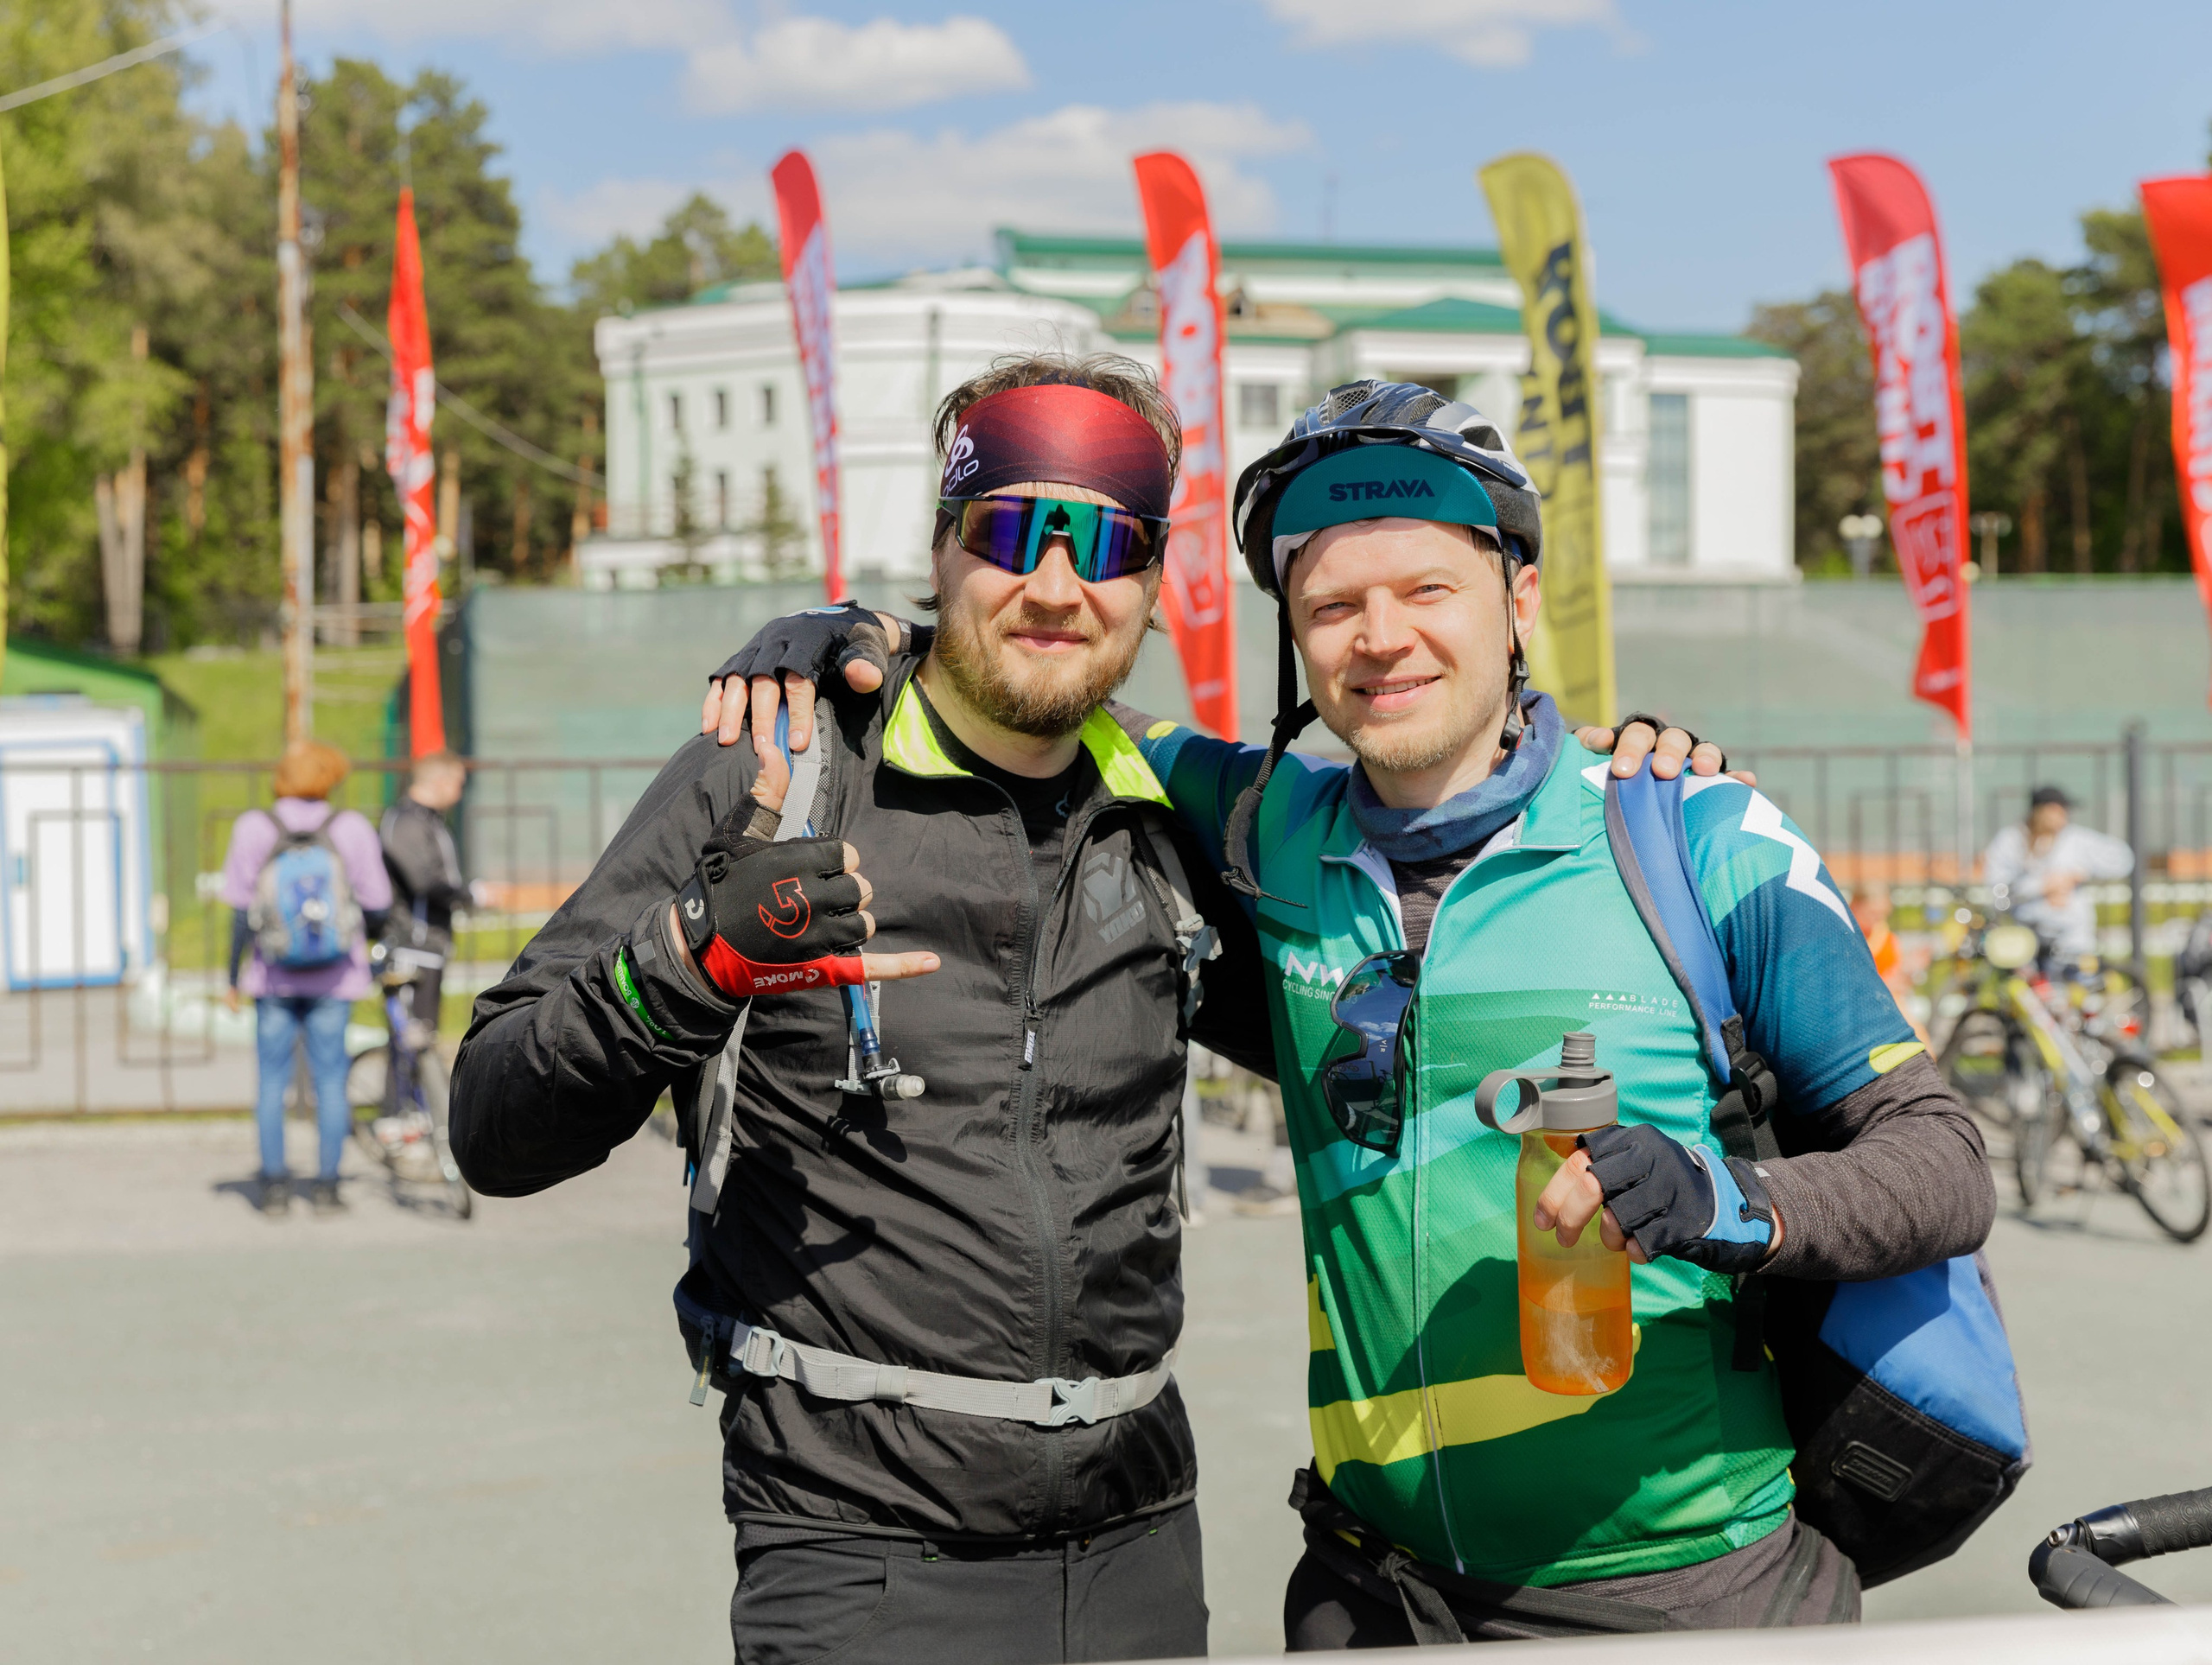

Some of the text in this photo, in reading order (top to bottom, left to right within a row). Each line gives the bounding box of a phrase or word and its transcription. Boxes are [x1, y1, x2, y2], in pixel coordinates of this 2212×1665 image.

[1328, 480, 1435, 502] STRAVA
[1282, 979, 1313, 999] CYCLING
[1314, 989, 1336, 1002] SINC
[1588, 1002, 1677, 1018] PERFORMANCE LINE
[1630, 994, 1678, 1008] BLADE
